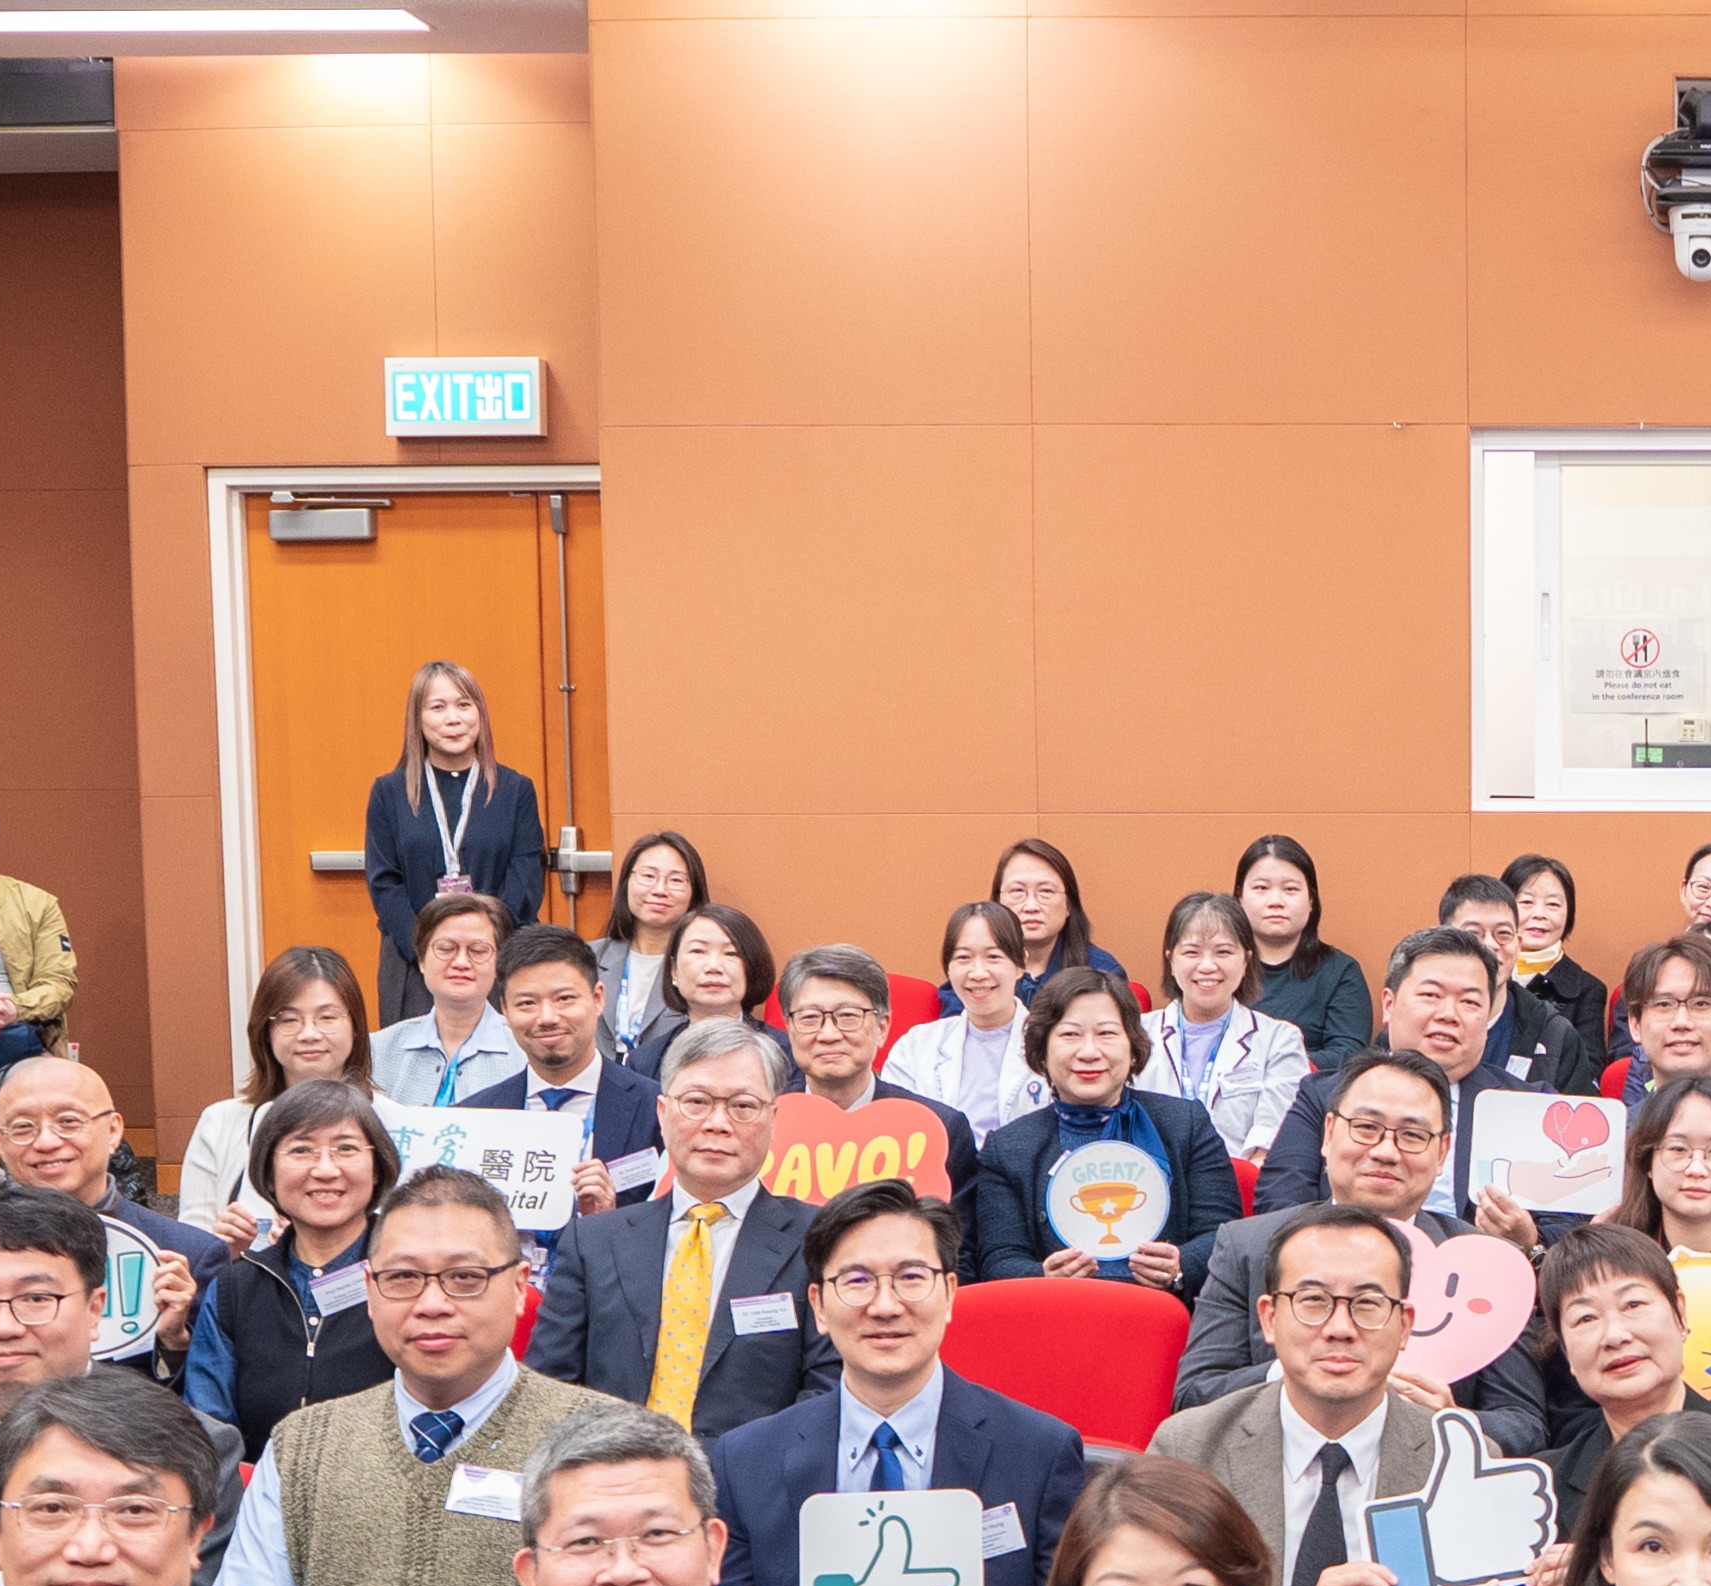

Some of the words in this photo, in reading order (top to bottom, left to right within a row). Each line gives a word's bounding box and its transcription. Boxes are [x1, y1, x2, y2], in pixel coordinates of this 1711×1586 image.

[395, 374, 474, 420] EXIT
[475, 374, 531, 420] 出口
[1601, 693, 1615, 701] the
[1616, 692, 1661, 701] conference
[1662, 693, 1684, 701] room
[1603, 681, 1630, 689] Please
[1631, 681, 1642, 689] do
[1072, 1160, 1146, 1184] GREAT!
